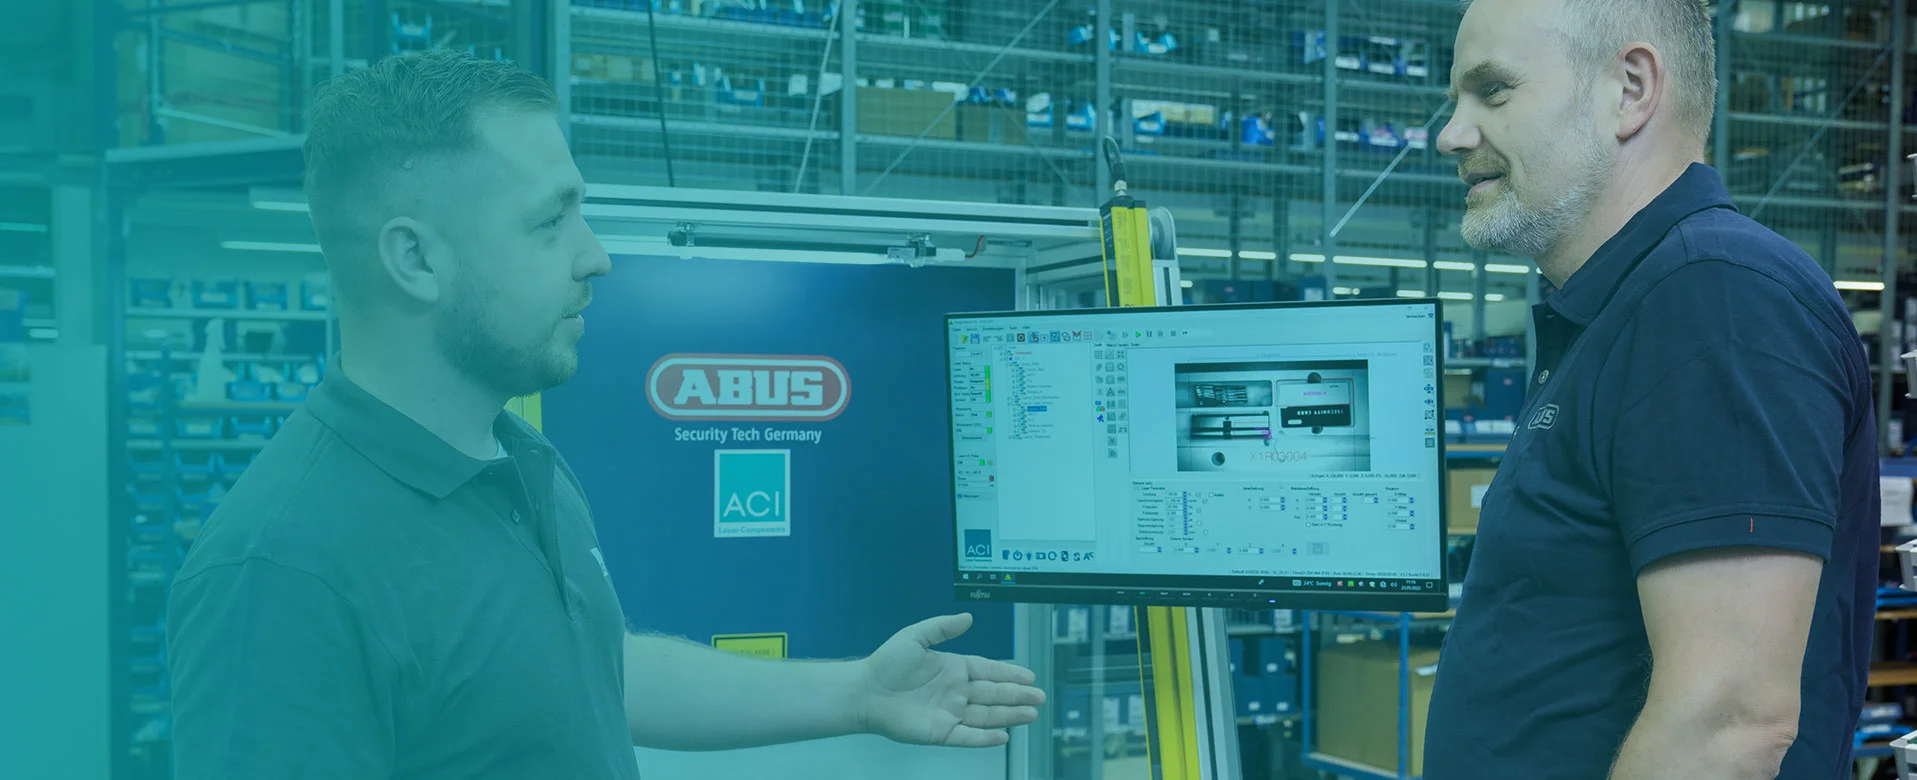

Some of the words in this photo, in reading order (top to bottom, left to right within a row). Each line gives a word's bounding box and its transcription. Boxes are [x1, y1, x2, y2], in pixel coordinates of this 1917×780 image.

[674, 369, 823, 406] ABUS
[674, 427, 728, 444] Security
[731, 427, 760, 441] Tech
[764, 427, 822, 444] Germany
[723, 490, 780, 517] ACI
[966, 544, 990, 556] ACI
